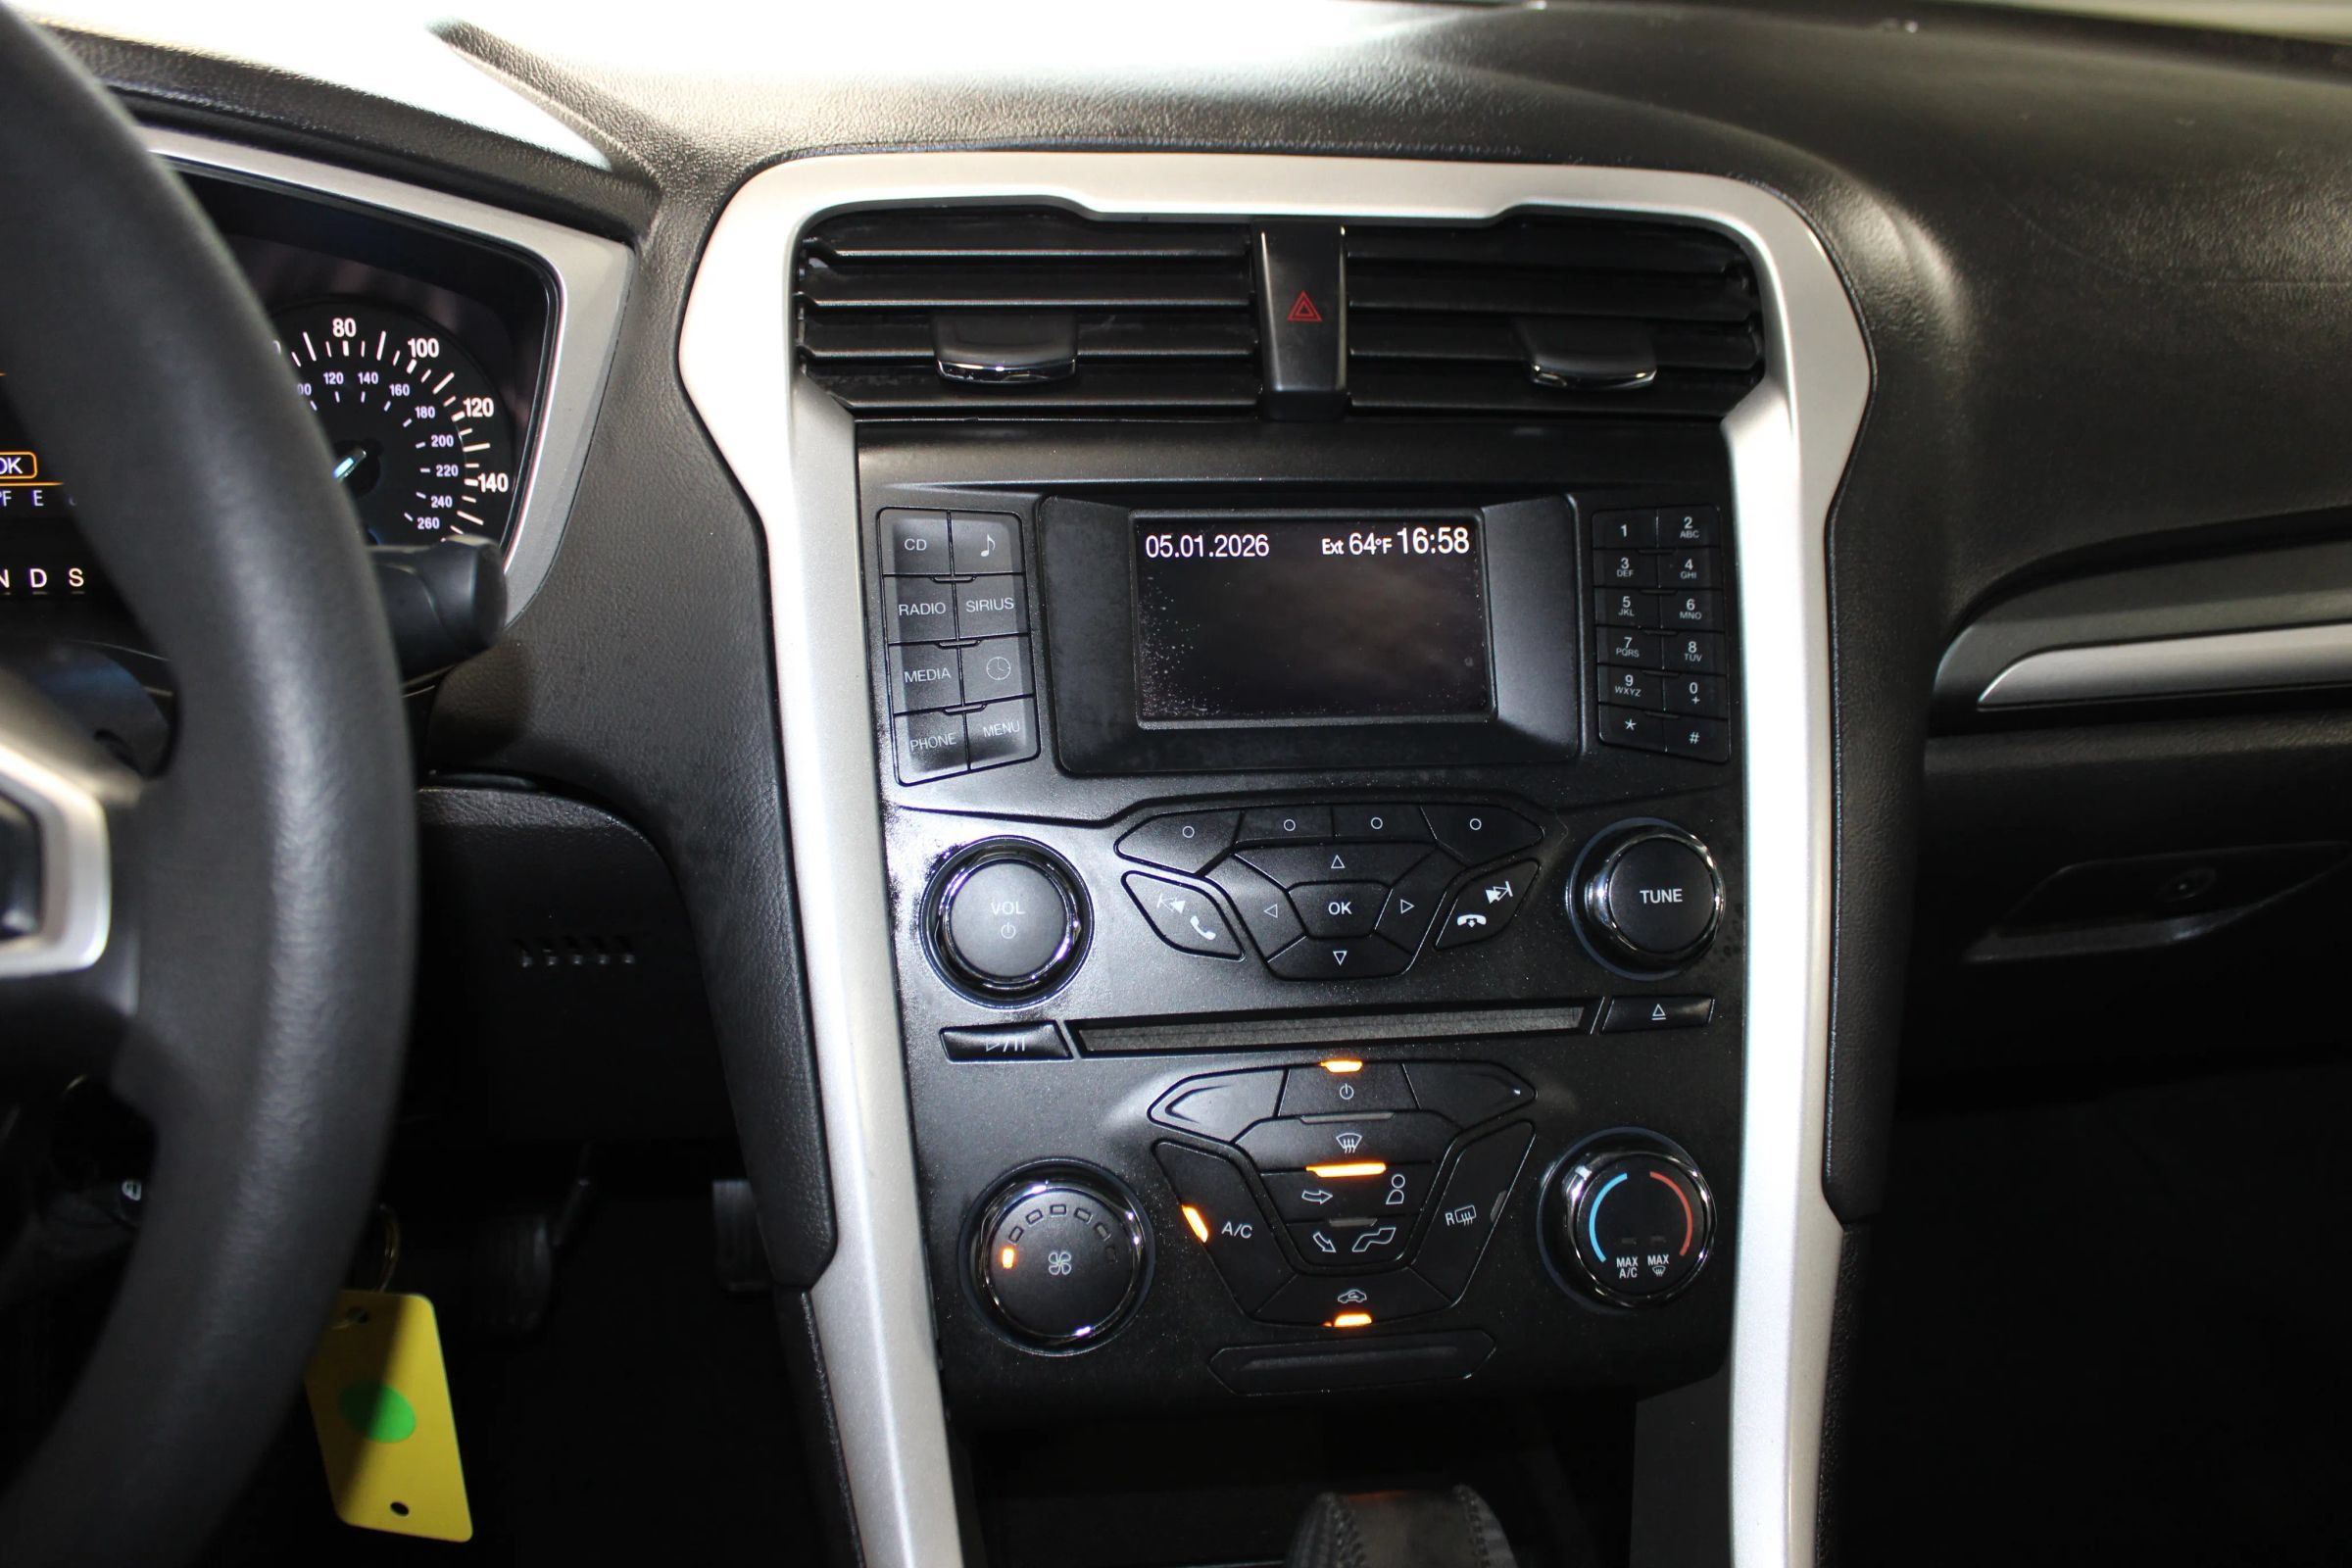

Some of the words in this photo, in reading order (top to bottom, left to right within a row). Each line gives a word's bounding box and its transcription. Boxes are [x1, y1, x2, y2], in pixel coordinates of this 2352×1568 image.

[332, 318, 357, 338] 80
[407, 337, 440, 359] 100
[322, 371, 344, 385] 120
[358, 371, 379, 385] 140
[389, 383, 411, 397] 160
[415, 405, 436, 419] 180
[464, 397, 495, 417] 120
[430, 434, 455, 448] 200
[435, 464, 460, 477] 220
[475, 472, 510, 493] 140
[430, 495, 453, 509] 240
[416, 516, 440, 530] 260
[1684, 515, 1693, 528] 2
[1620, 523, 1628, 537] 1
[1679, 530, 1699, 539] ABC
[904, 538, 927, 551] CD
[1145, 533, 1270, 559] 05.01.2026
[1321, 538, 1345, 556] Ext
[1396, 526, 1470, 555] 16:58
[1620, 557, 1630, 569] 3
[1684, 558, 1693, 569] 4
[29, 567, 48, 588] D
[69, 567, 84, 587] S
[1680, 571, 1697, 580] GHI
[899, 601, 947, 616] RADIO
[965, 597, 1014, 613] SIRIUS
[1622, 595, 1632, 608] 5
[1686, 598, 1695, 611] 6
[1618, 609, 1635, 617] JKL
[1679, 612, 1702, 620] MNO
[1624, 636, 1633, 648] 7
[1688, 640, 1697, 653] 8
[1615, 648, 1640, 659] PQRS
[1684, 654, 1702, 662] TUV
[904, 666, 952, 684] MEDIA
[1625, 674, 1634, 686] 9
[1614, 687, 1642, 698] WXYZ
[1689, 681, 1698, 695] 0
[983, 720, 1020, 738] MENU
[909, 732, 956, 753] PHONE
[1639, 888, 1684, 905] TUNE
[991, 901, 1025, 916] VOL
[1328, 901, 1352, 915] OK
[1221, 1223, 1253, 1240] A/C
[1616, 1256, 1639, 1270] MAX
[1646, 1253, 1670, 1268] MAX
[1618, 1267, 1638, 1279] A/C
